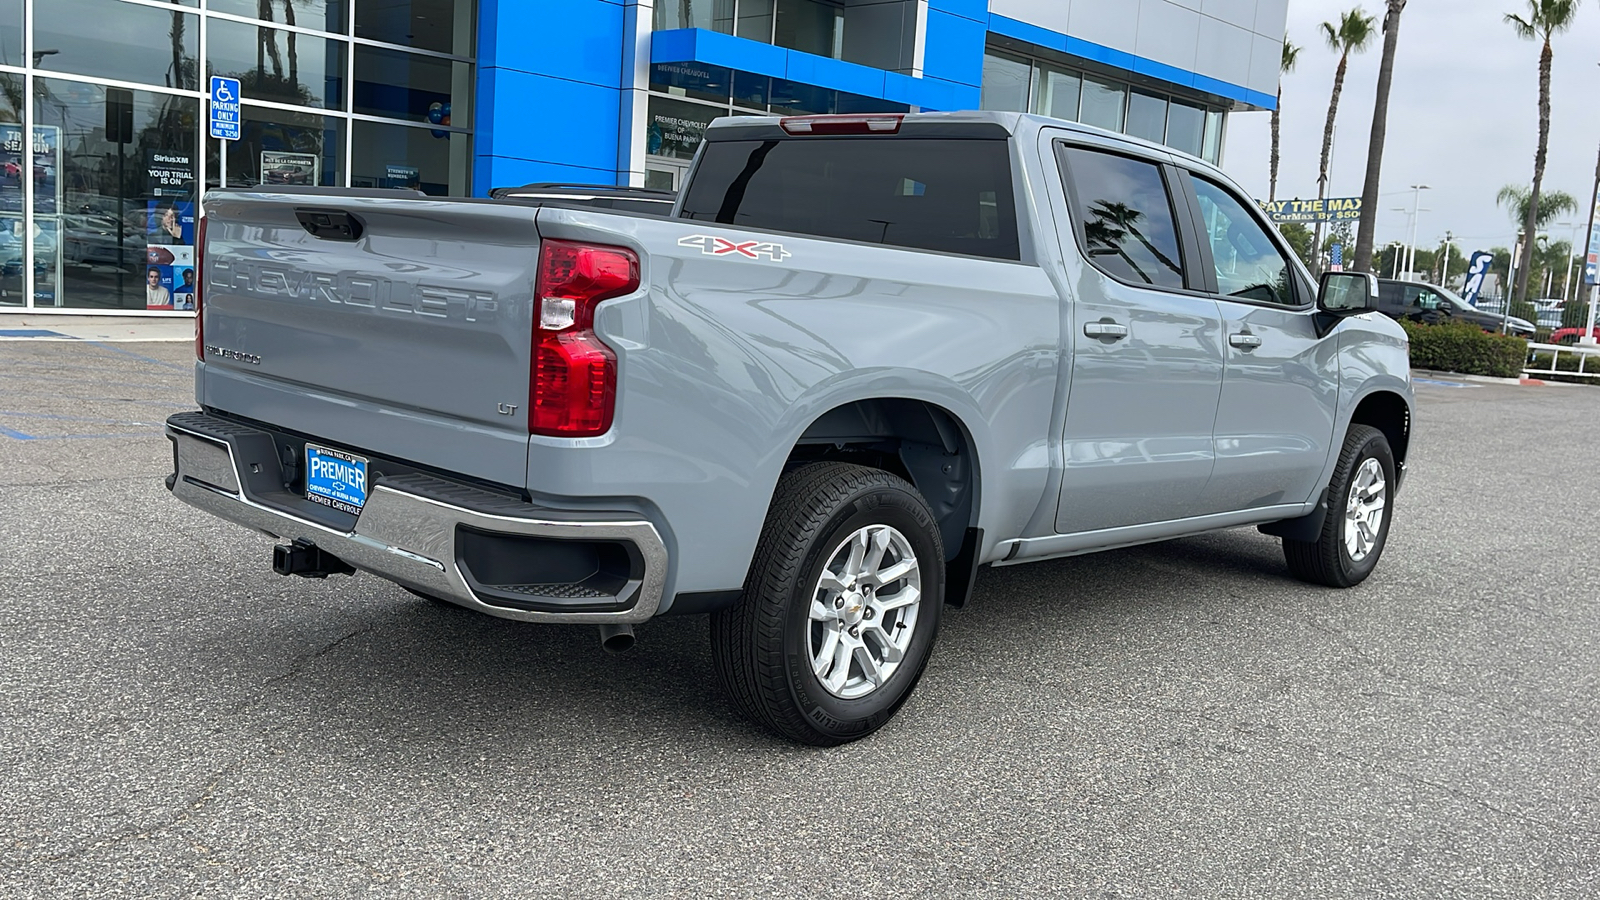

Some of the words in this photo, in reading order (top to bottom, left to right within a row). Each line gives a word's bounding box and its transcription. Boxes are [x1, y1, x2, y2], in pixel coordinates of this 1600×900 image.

[212, 101, 238, 112] PARKING
[218, 111, 233, 120] ONLY
[654, 115, 677, 125] PREMIER
[678, 119, 707, 129] CHEVROLET
[6, 130, 45, 143] TRCK
[664, 133, 682, 141] BUENA
[4, 141, 49, 153] SEAON
[154, 154, 188, 164] SiriusXM
[171, 171, 193, 179] TRIAL
[1291, 201, 1323, 212] THE
[1328, 198, 1362, 211] MAX
[208, 258, 498, 322] CHEVROLET
[498, 402, 518, 416] LT
[311, 457, 365, 493] PREMIER
[308, 492, 331, 506] PREMIER
[332, 500, 362, 515] CHEVROLE
[880, 494, 927, 523] MIHELIN
